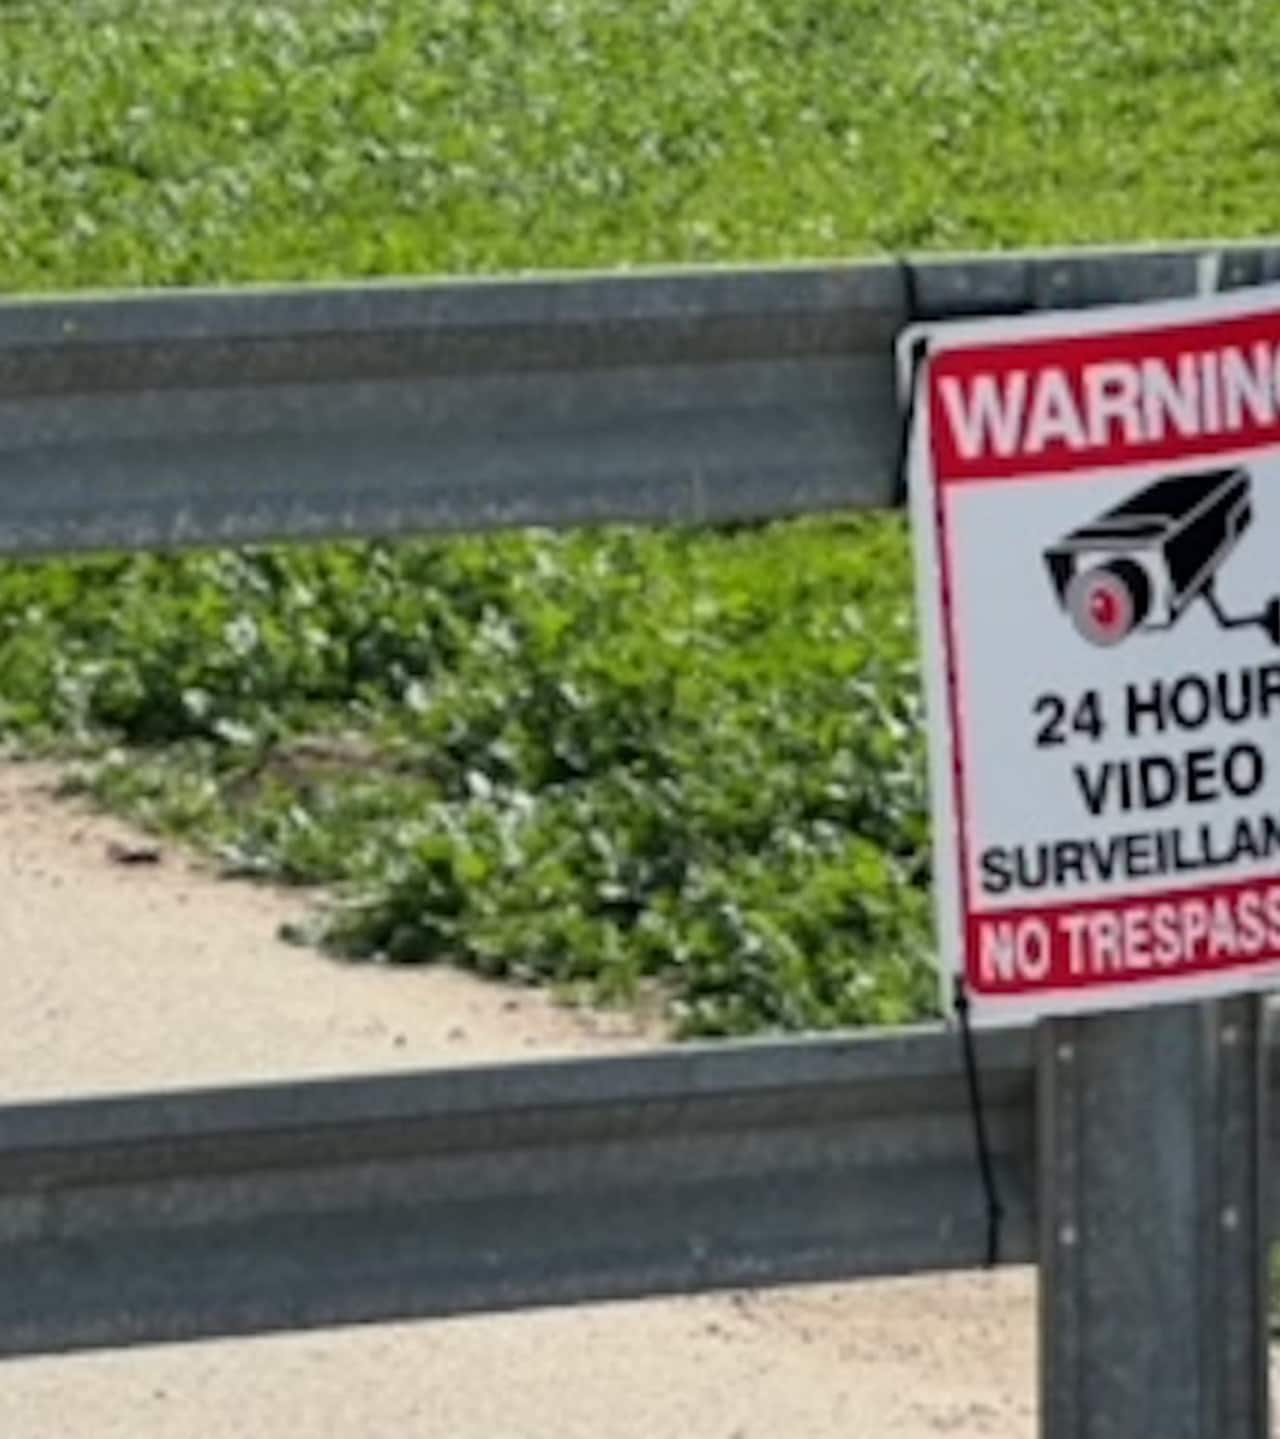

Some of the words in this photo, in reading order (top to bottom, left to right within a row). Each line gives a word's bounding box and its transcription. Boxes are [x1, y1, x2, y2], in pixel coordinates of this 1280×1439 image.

[1033, 690, 1105, 749] 24
[1073, 741, 1265, 816] VIDEO
[978, 918, 1051, 982] NO
